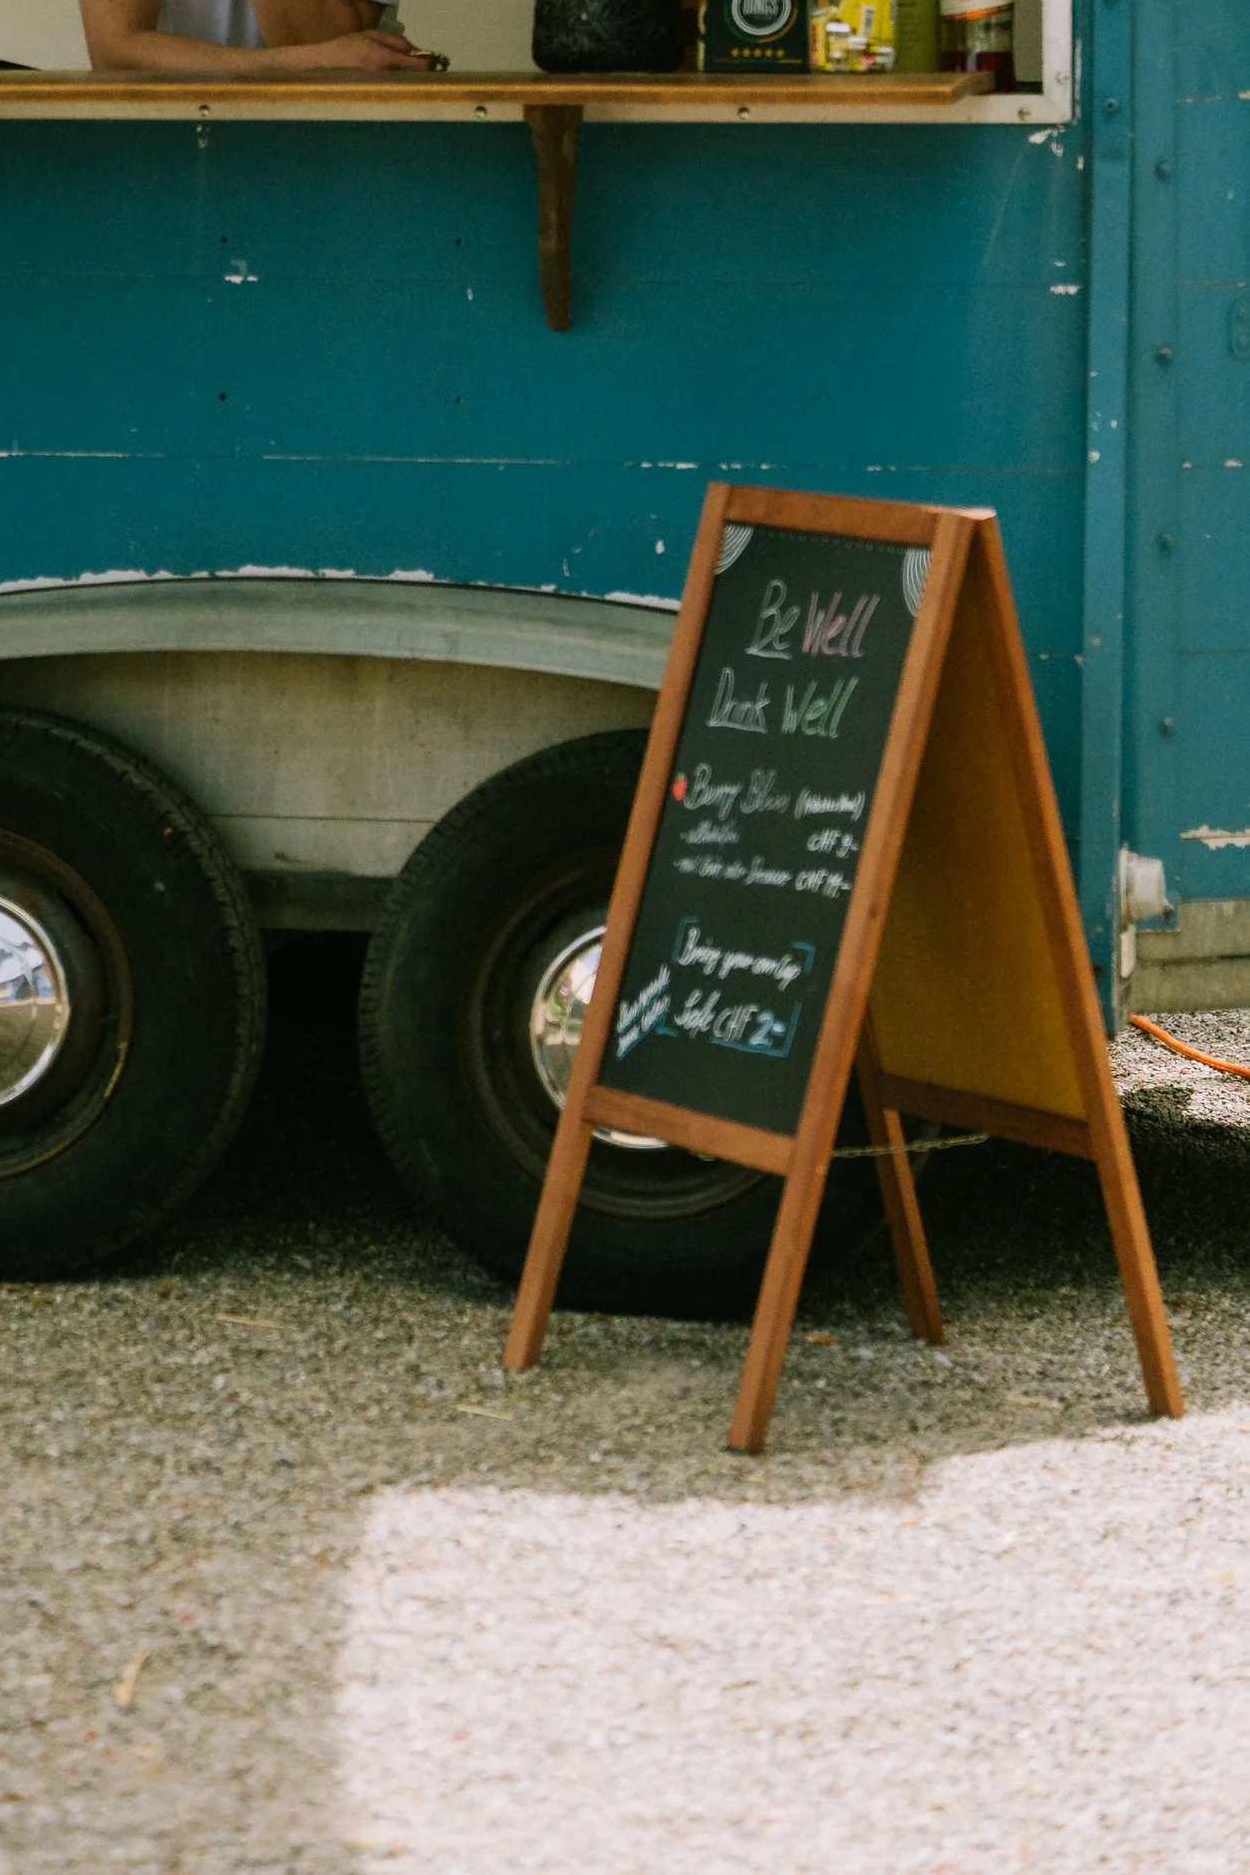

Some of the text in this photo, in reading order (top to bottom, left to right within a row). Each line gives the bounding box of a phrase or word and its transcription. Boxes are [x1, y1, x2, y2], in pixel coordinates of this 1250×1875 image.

[745, 579, 881, 660] Be Well
[707, 667, 860, 738] Drink Well
